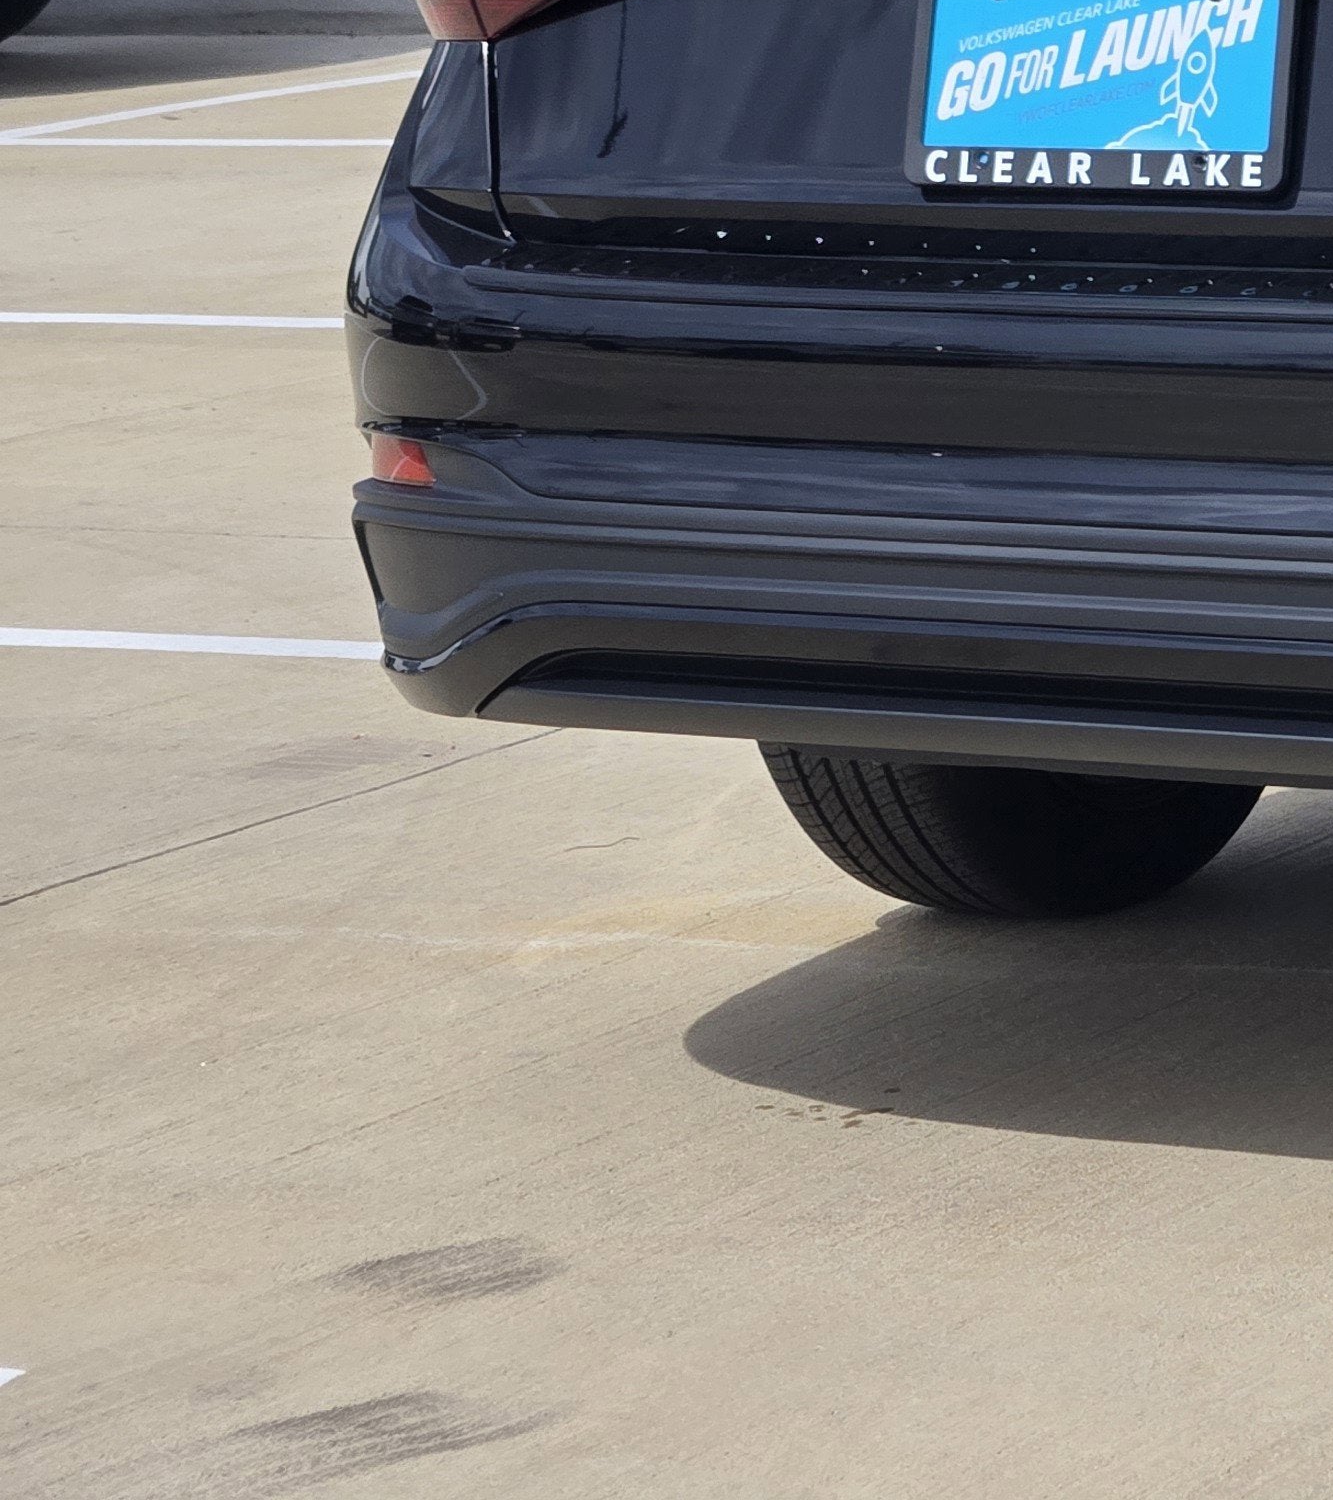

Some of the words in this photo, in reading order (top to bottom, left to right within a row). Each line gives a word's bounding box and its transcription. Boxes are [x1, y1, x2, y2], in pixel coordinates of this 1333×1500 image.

[958, 16, 1055, 53] VOLKSWAGEN
[1057, 1, 1103, 28] CLEAR
[936, 51, 1007, 122] GO
[1004, 44, 1060, 100] FOR
[925, 150, 1092, 184] CLEAR
[1130, 153, 1264, 187] LAKE
